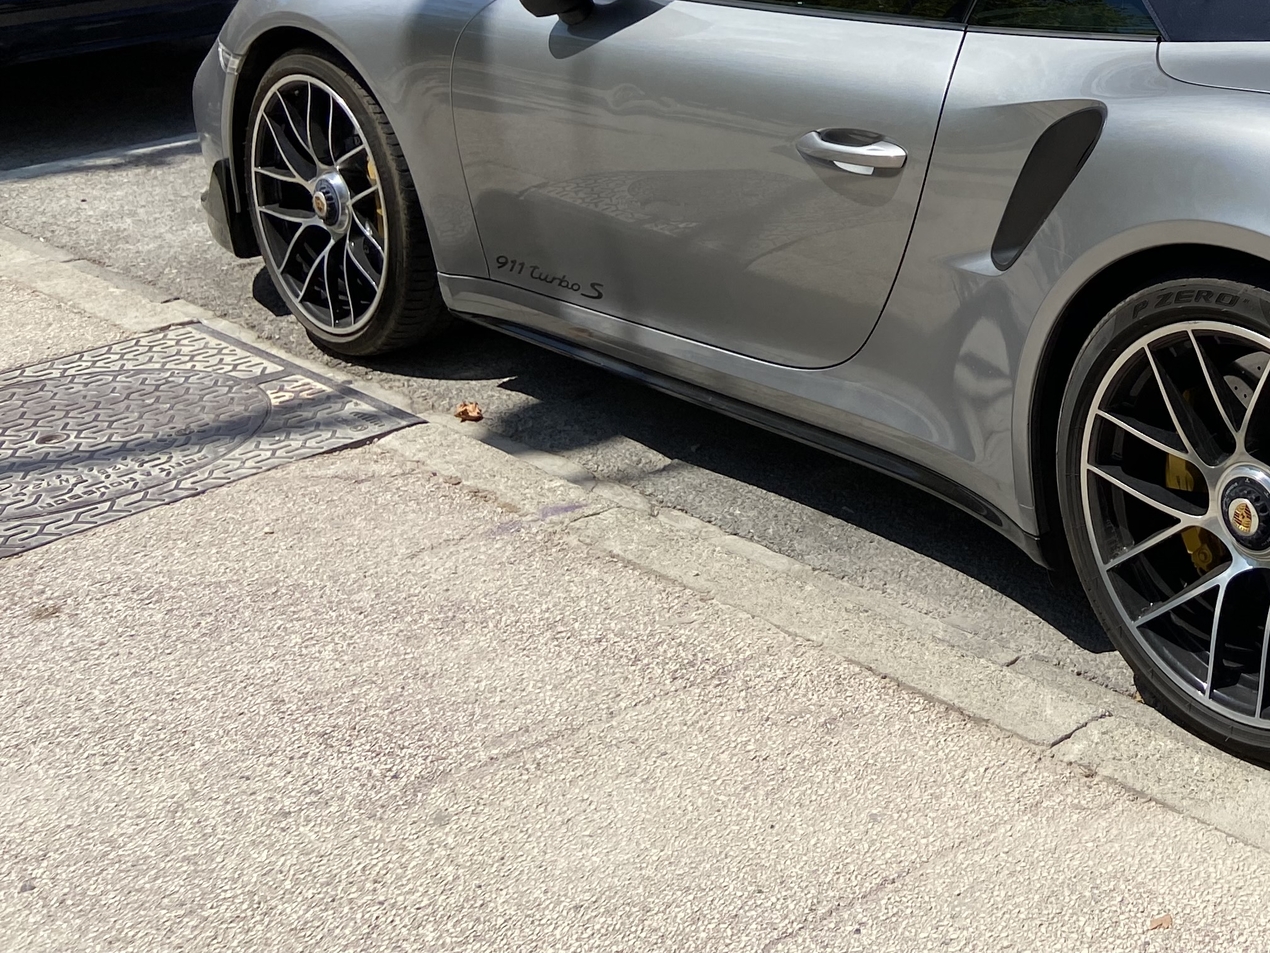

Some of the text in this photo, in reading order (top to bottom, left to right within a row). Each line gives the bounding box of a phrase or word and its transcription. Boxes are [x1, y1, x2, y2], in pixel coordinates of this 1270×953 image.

[496, 255, 526, 275] 911
[581, 282, 604, 300] S
[1132, 289, 1240, 319] P ZERO
